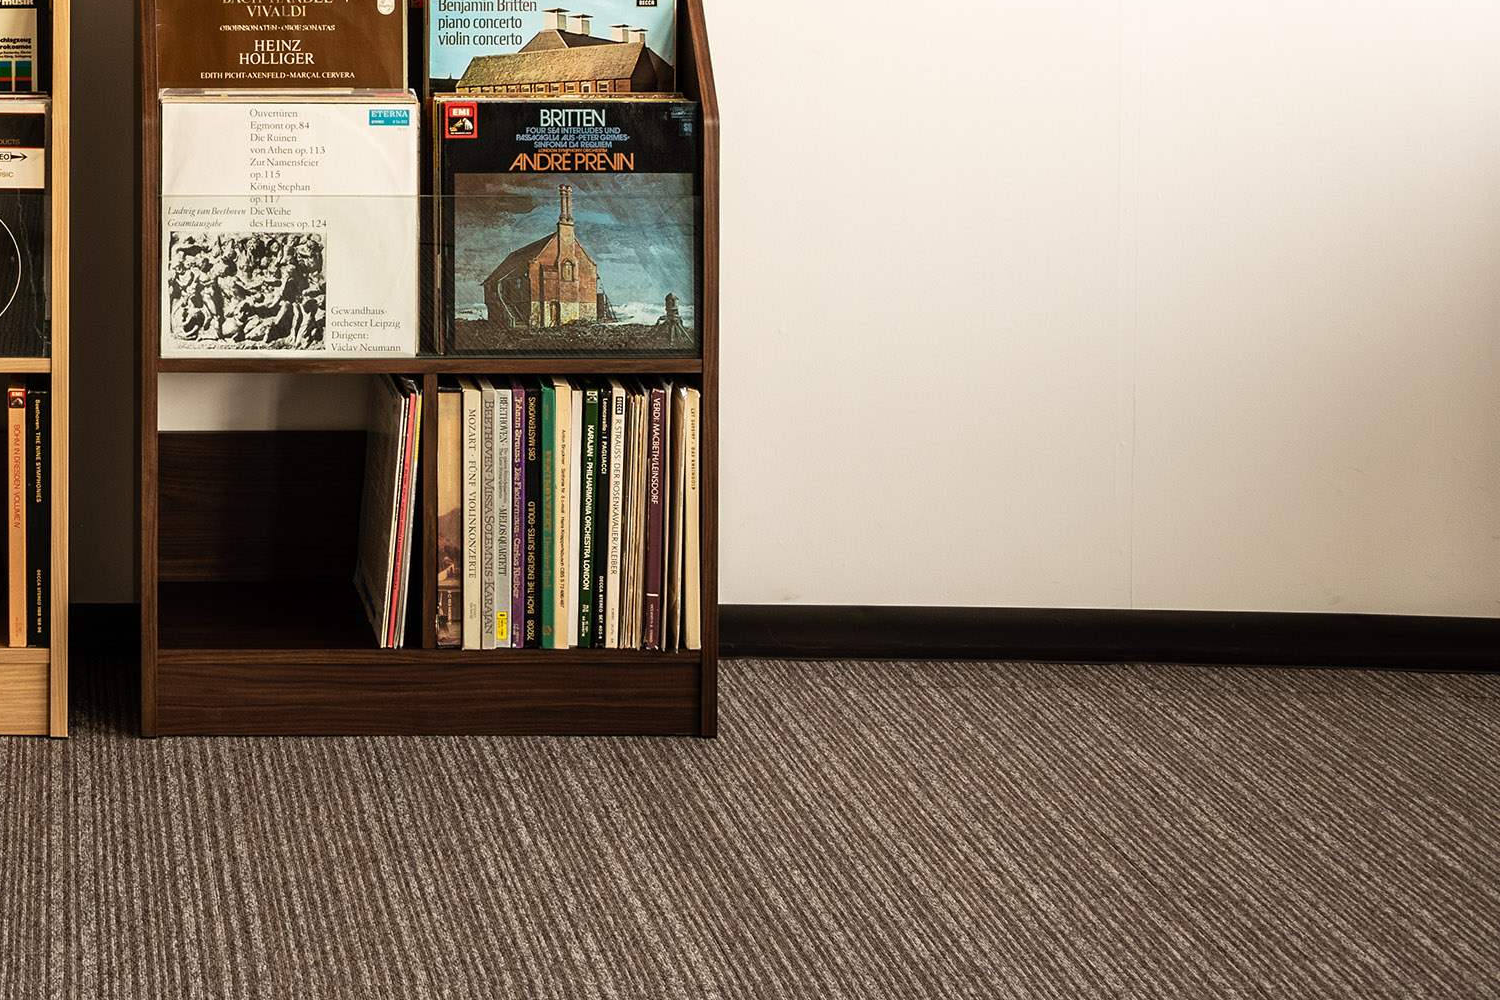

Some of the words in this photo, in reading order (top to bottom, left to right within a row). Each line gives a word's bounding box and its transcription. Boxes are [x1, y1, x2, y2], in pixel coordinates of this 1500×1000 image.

[247, 5, 306, 17] VIVALDI
[438, 16, 470, 31] piano
[473, 17, 522, 28] concerto
[438, 31, 469, 45] violin
[473, 33, 522, 45] concerto
[255, 40, 301, 51] HEINZ
[239, 53, 314, 65] HOLLIGER
[250, 109, 298, 117] Ouvertüren
[540, 109, 605, 126] BRITTEN
[509, 151, 571, 170] ANDRÉ
[575, 153, 634, 170] PREVIN
[168, 207, 195, 216] Ludwig
[211, 207, 246, 215] Beethoven
[468, 409, 476, 451] MOZART
[468, 491, 477, 578] VIOLINKONZERTE
